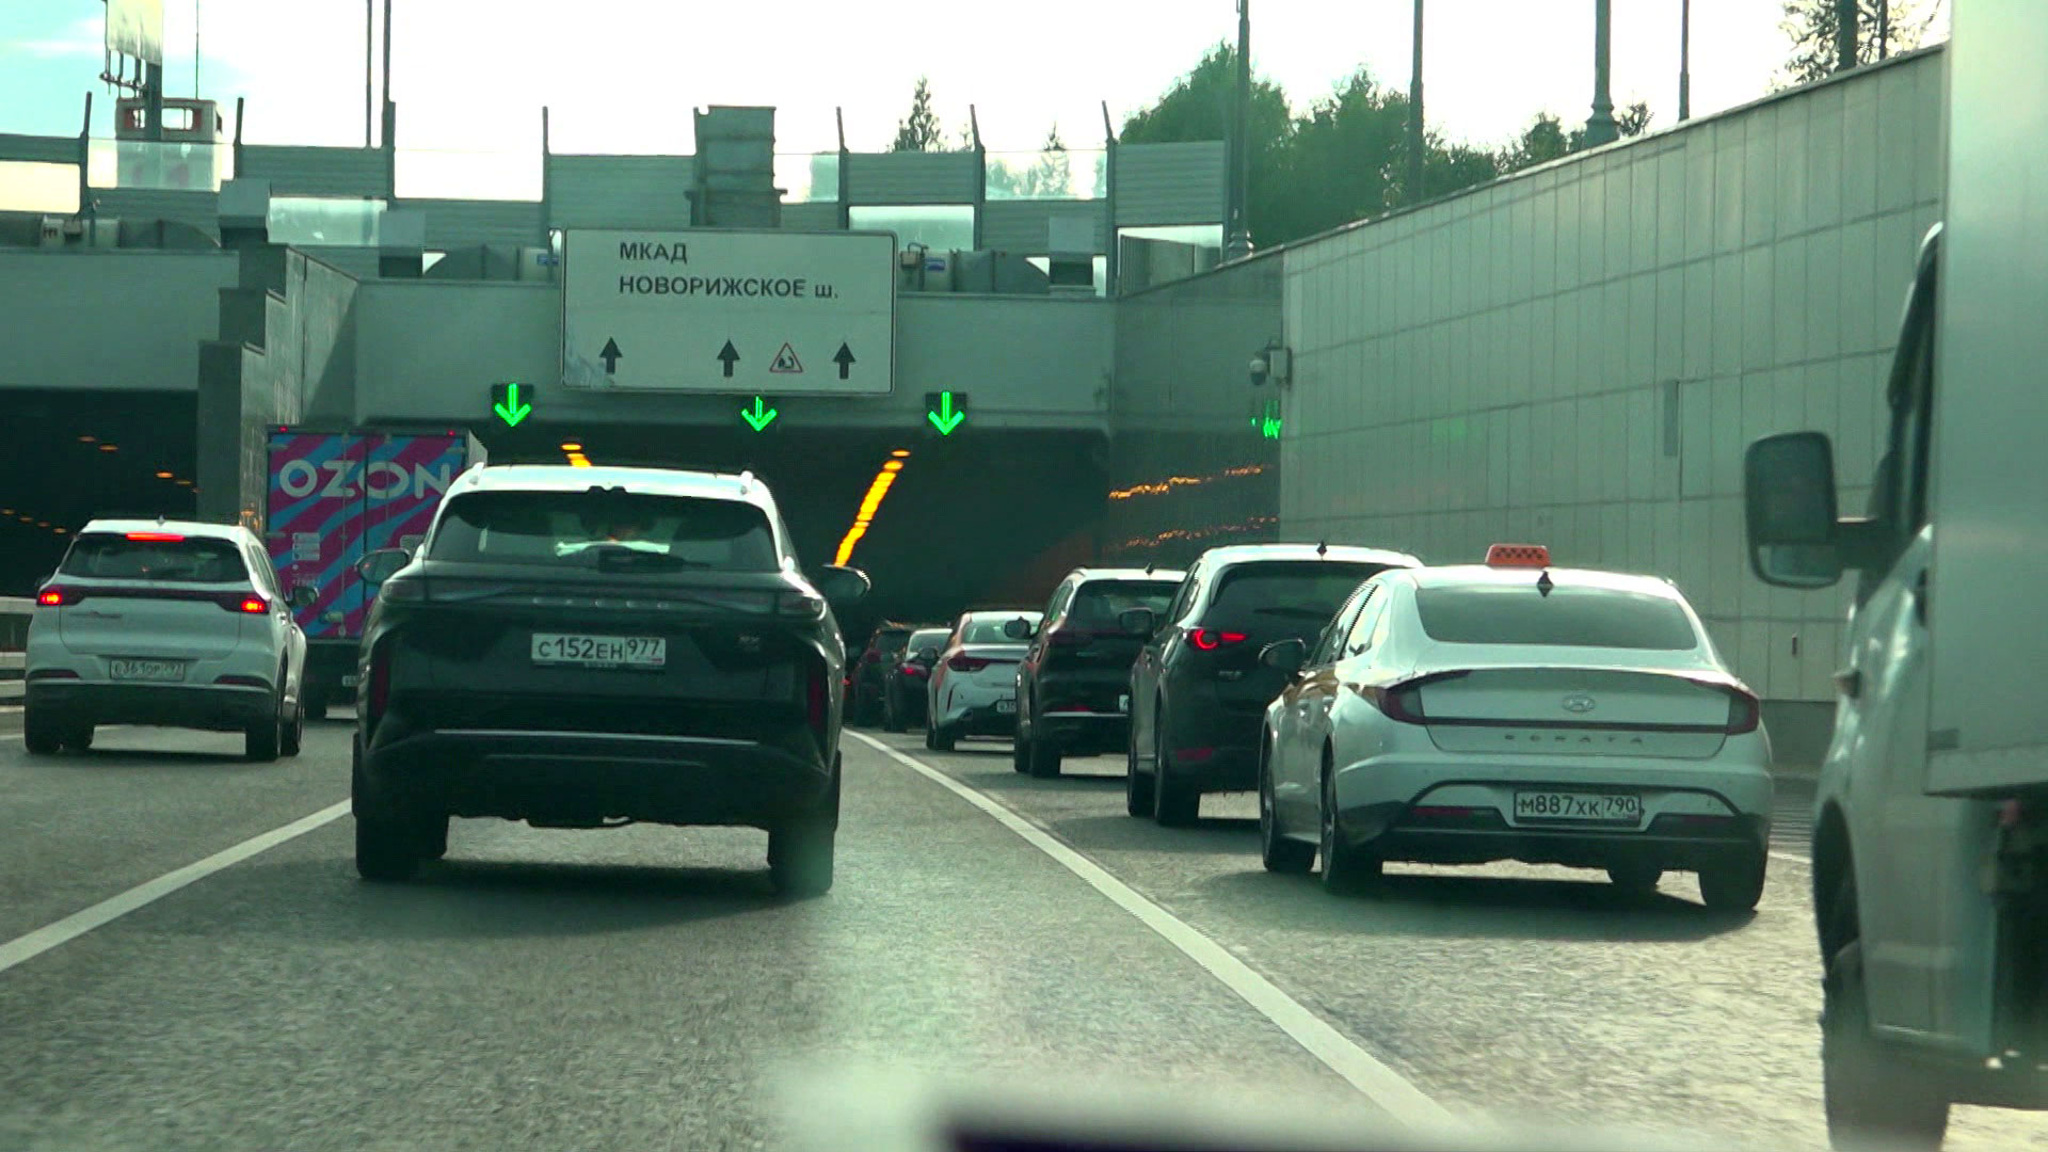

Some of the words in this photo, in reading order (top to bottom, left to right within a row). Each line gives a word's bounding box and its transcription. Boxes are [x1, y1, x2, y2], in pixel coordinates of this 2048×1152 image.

[619, 242, 687, 264] МКАД
[619, 275, 806, 298] НОВОРИЖСКОЕ
[814, 284, 839, 299] ш.
[279, 459, 451, 499] OZON
[538, 637, 623, 659] С152ЕН
[627, 639, 660, 656] 977
[1519, 794, 1599, 817] М887ХК
[1604, 797, 1637, 813] 790
